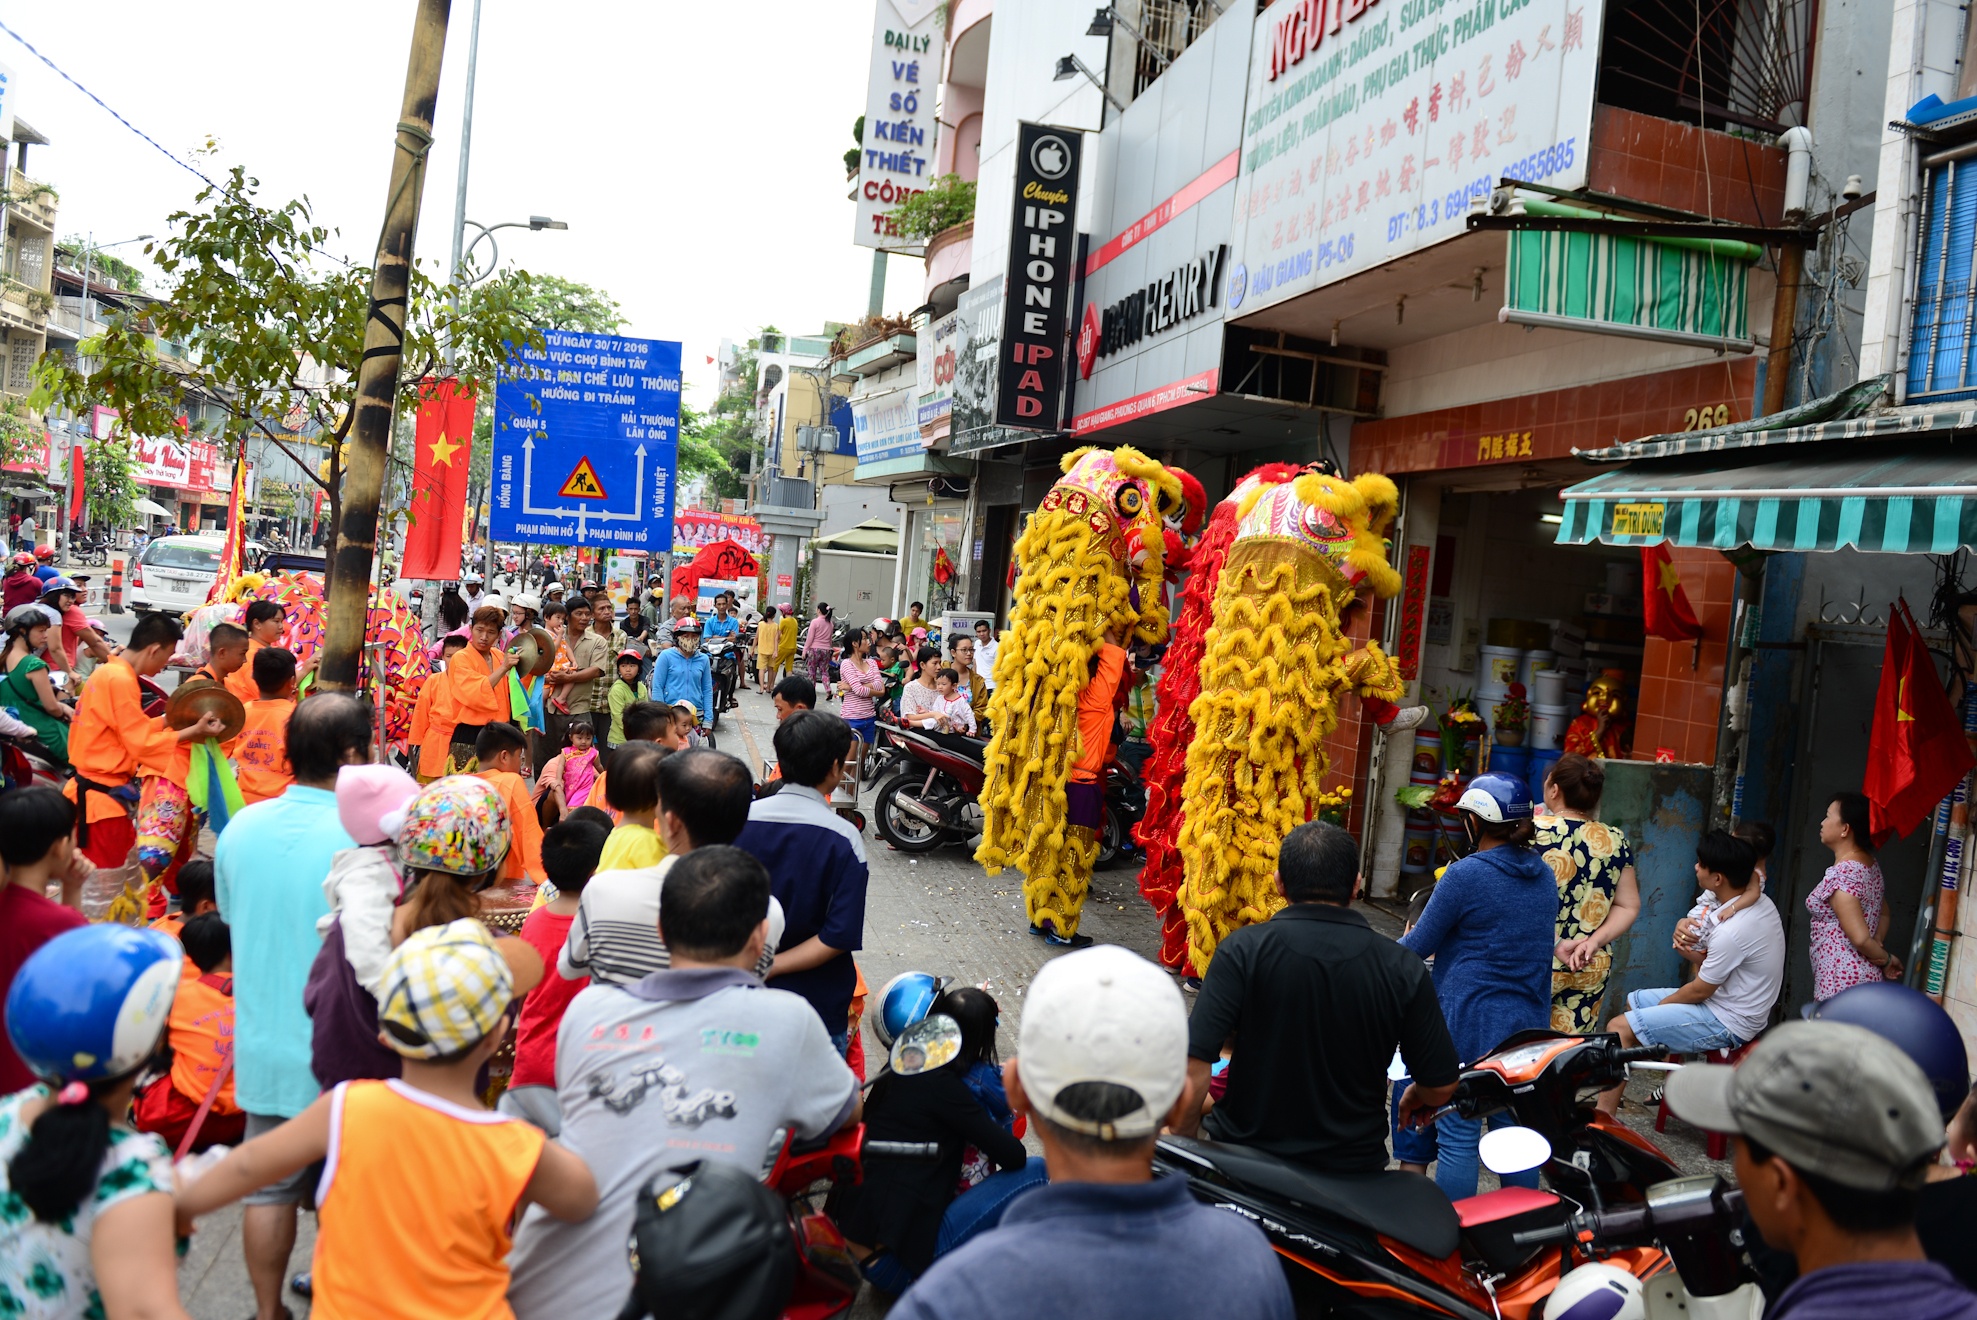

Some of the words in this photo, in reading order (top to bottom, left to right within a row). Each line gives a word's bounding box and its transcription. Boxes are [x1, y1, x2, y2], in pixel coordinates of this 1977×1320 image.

[884, 29, 911, 52] ĐẠI
[913, 33, 931, 55] LÝ
[1389, 49, 1409, 88] GIA
[1413, 22, 1449, 73] THỰC
[892, 59, 920, 84] VÉ
[889, 88, 921, 115] SỐ
[1284, 74, 1307, 113] KINH
[874, 118, 925, 147] KIẾN
[865, 148, 926, 177] THIẾT
[1022, 180, 1070, 206] Chuyên
[1251, 262, 1275, 297] HẬU
[1275, 248, 1313, 288] GIANG
[1145, 243, 1228, 337] HENRY
[545, 332, 561, 346] TỪ
[562, 334, 593, 349] NGÀY
[549, 350, 573, 366] VỰC
[574, 353, 599, 369] CHỢ
[600, 353, 626, 368] BÌNH
[627, 356, 648, 370] TÂY
[583, 368, 609, 386] CHẾ
[612, 373, 635, 388] LƯU
[641, 375, 679, 392] THÔNG
[541, 385, 580, 401] HƯỚNG
[583, 391, 596, 402] ĐI
[597, 390, 636, 406] TRÁNH
[512, 416, 539, 432] QUẬN
[540, 419, 547, 430] 5
[621, 411, 637, 424] HẢI
[640, 413, 676, 429] THƯỢNG
[1684, 404, 1729, 433] 269
[648, 428, 668, 440] ÔNG
[498, 454, 513, 481] BÀNG
[654, 466, 669, 487] KIỆT
[496, 481, 512, 509] HỒNG
[654, 486, 667, 506] VĂN
[652, 506, 665, 519] VÕ
[1628, 504, 1641, 533] TRÍ
[515, 523, 538, 537] PHẠM
[539, 523, 560, 537] ĐÌNH
[589, 528, 613, 542] PHẠM
[614, 528, 635, 542] ĐÌNH
